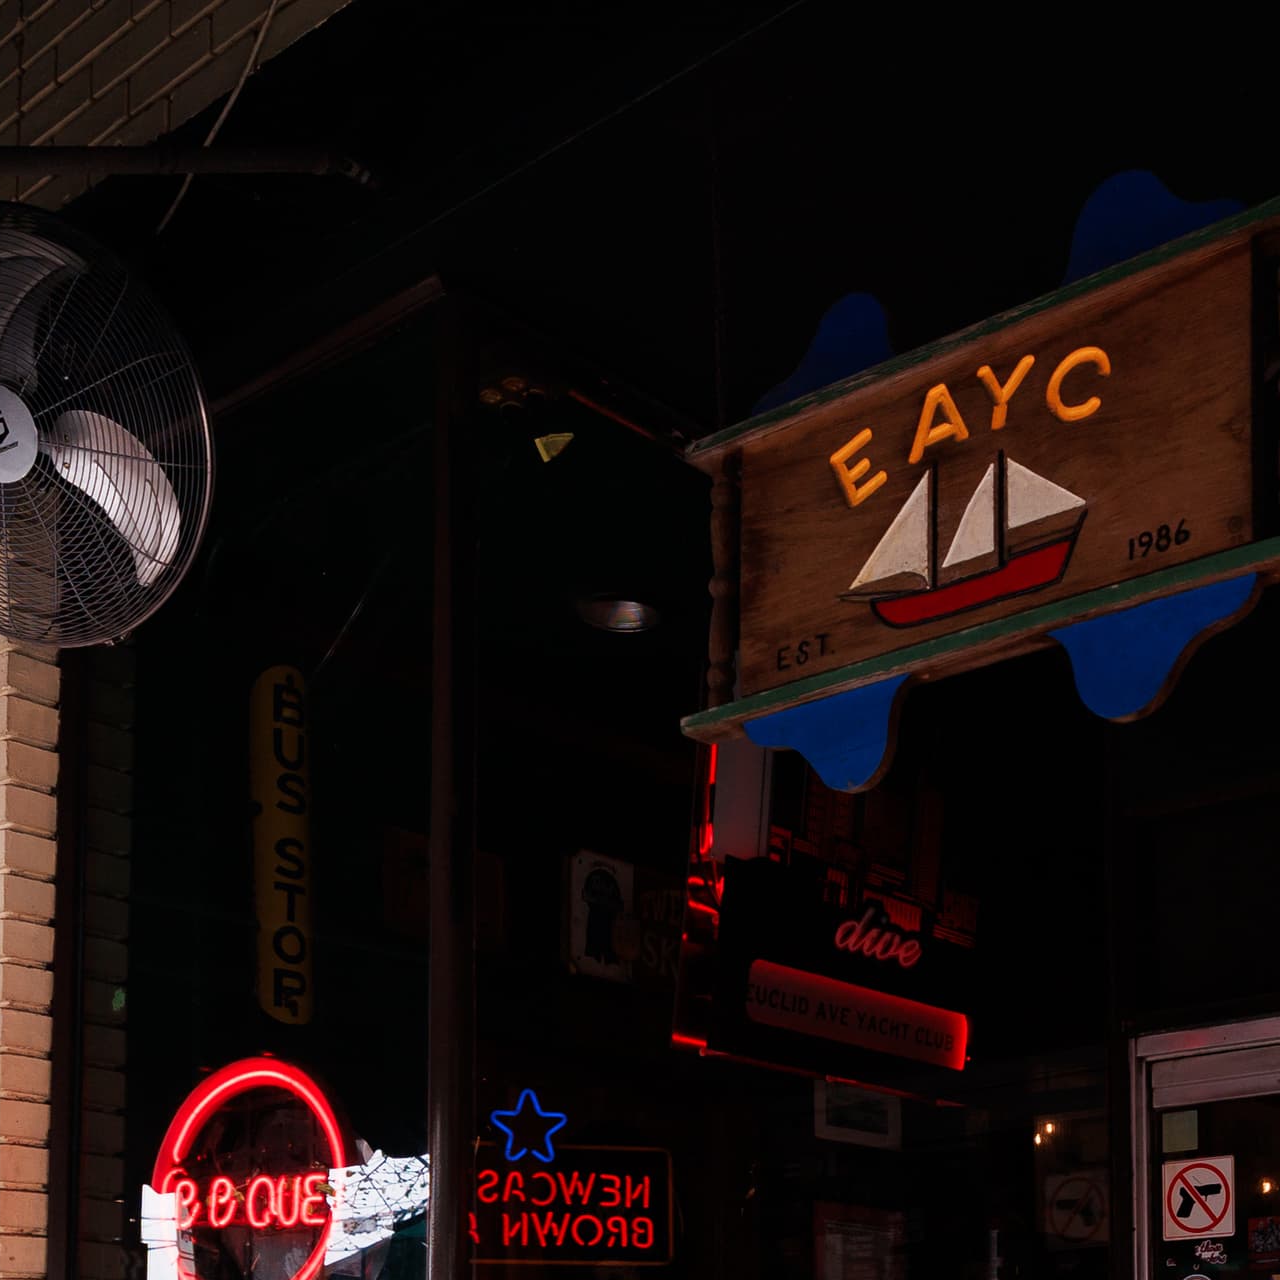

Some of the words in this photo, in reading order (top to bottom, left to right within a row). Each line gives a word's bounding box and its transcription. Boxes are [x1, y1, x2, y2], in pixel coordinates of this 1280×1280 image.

[1127, 518, 1191, 561] 1986
[834, 906, 922, 968] dive
[815, 1003, 849, 1027] AVE
[855, 1010, 910, 1041] YACHT
[915, 1026, 955, 1051] CLUB
